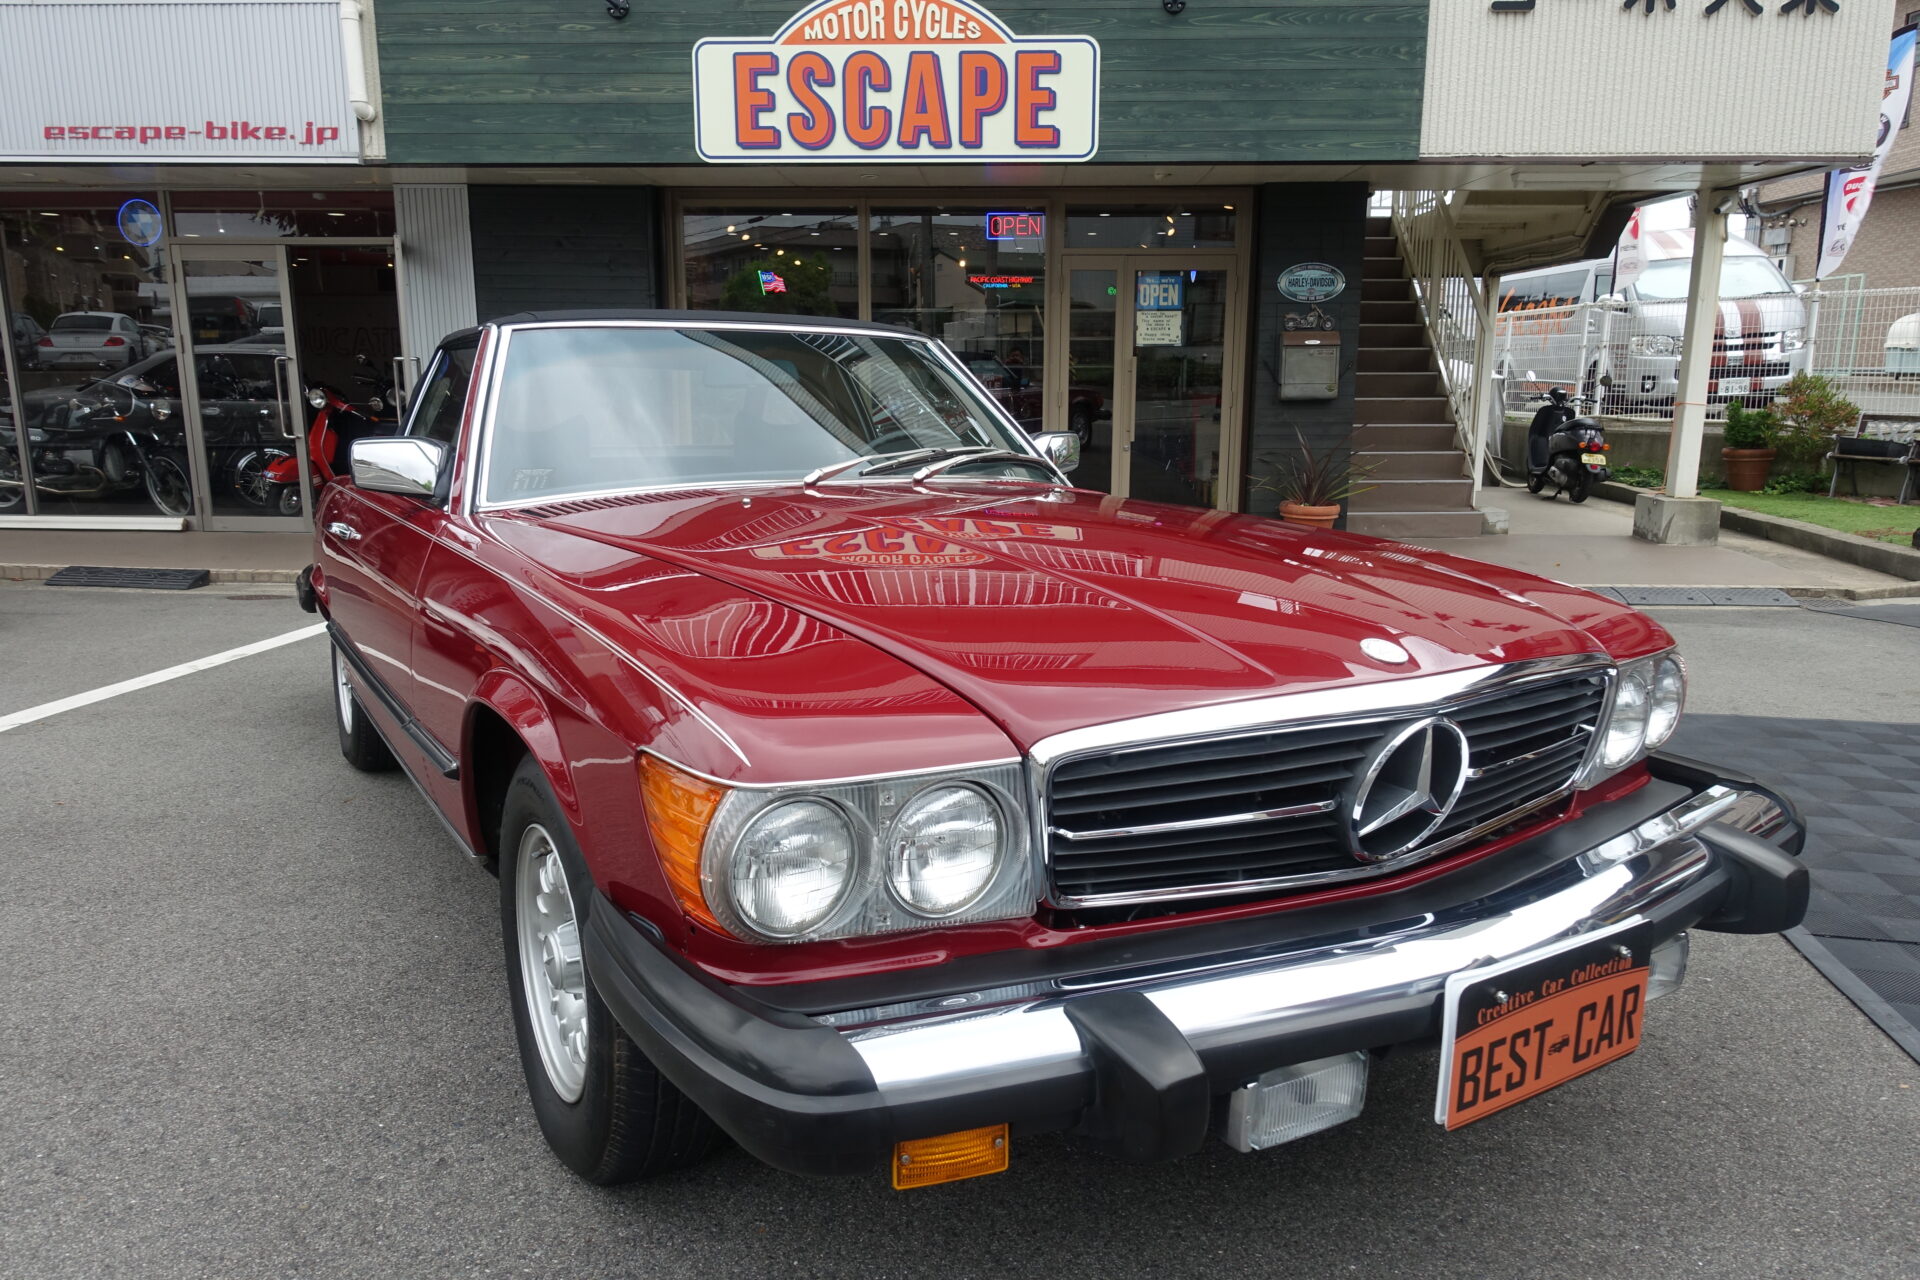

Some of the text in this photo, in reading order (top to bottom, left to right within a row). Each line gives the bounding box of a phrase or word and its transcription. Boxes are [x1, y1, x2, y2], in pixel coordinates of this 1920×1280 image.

[804, 0, 982, 40] MOTOR CYCLES
[732, 50, 1062, 150] ESCAPE
[44, 121, 339, 145] escape-bike.jp
[990, 216, 1041, 236] OPEN
[1139, 283, 1179, 306] OPEN
[1288, 277, 1336, 288] HARLEY-DAVIDSON
[1477, 957, 1633, 1025] Creative Car Collection
[1456, 984, 1640, 1113] BEST CAR
